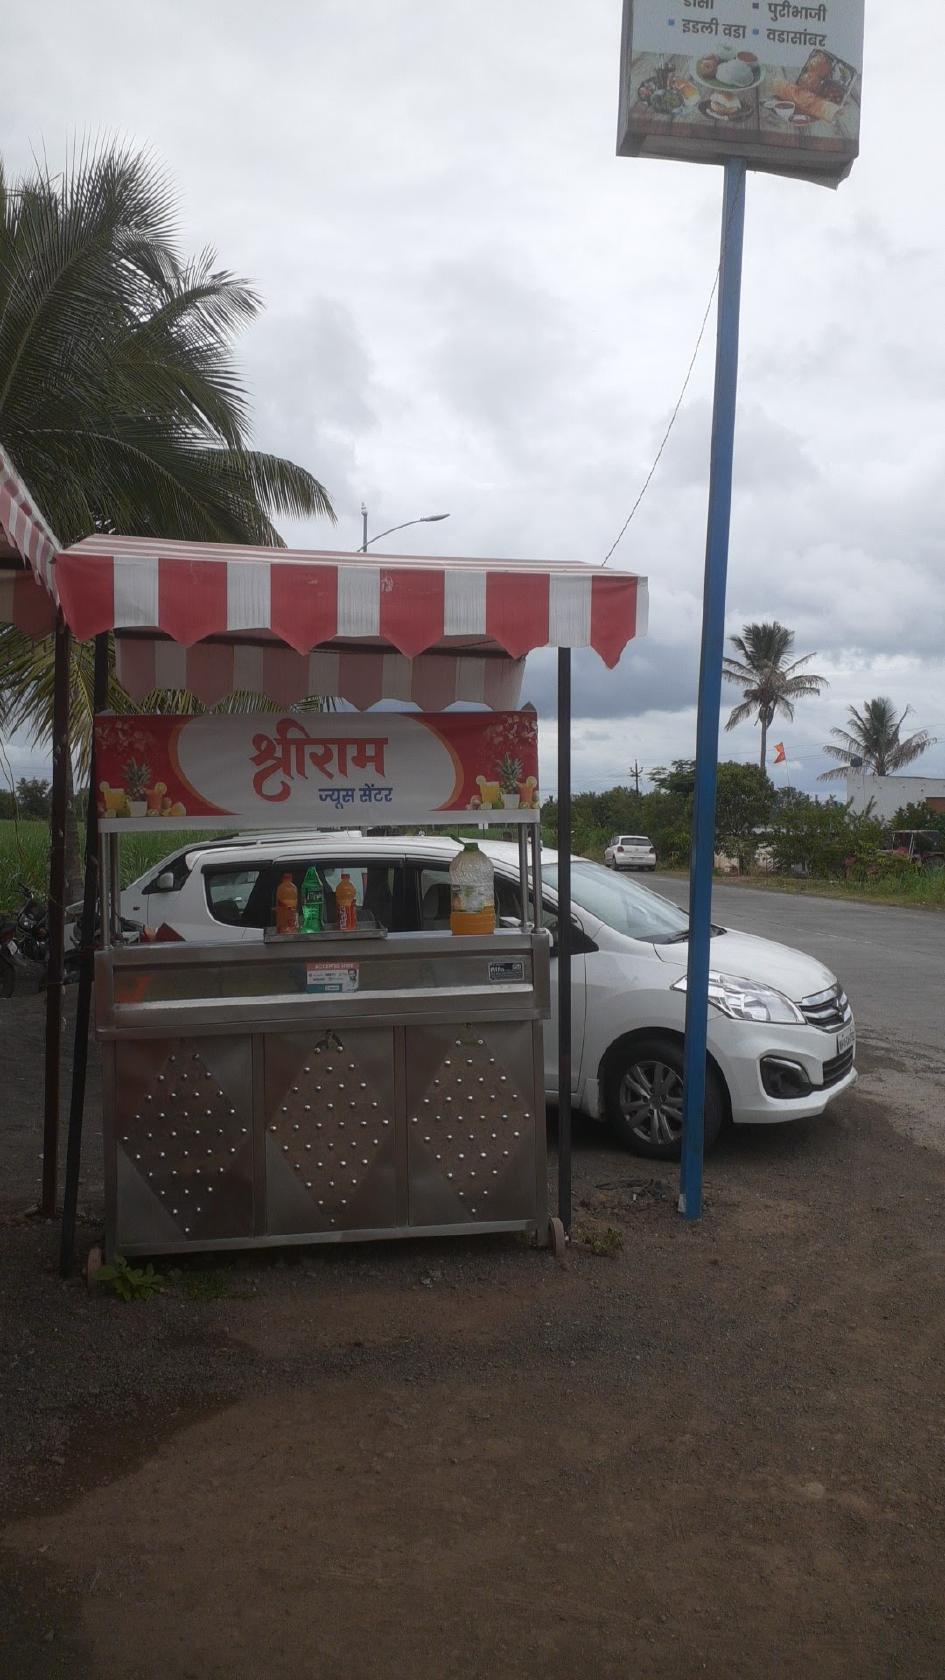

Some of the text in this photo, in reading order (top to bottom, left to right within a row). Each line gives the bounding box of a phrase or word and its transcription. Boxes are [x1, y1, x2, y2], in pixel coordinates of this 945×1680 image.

[768, 2, 827, 23] पुरीभाजी
[682, 17, 747, 39] इडली वडा
[766, 28, 827, 48] वडासांबर
[250, 718, 389, 802] श्रीराम
[318, 784, 393, 809] ज्यूस सेंटर
